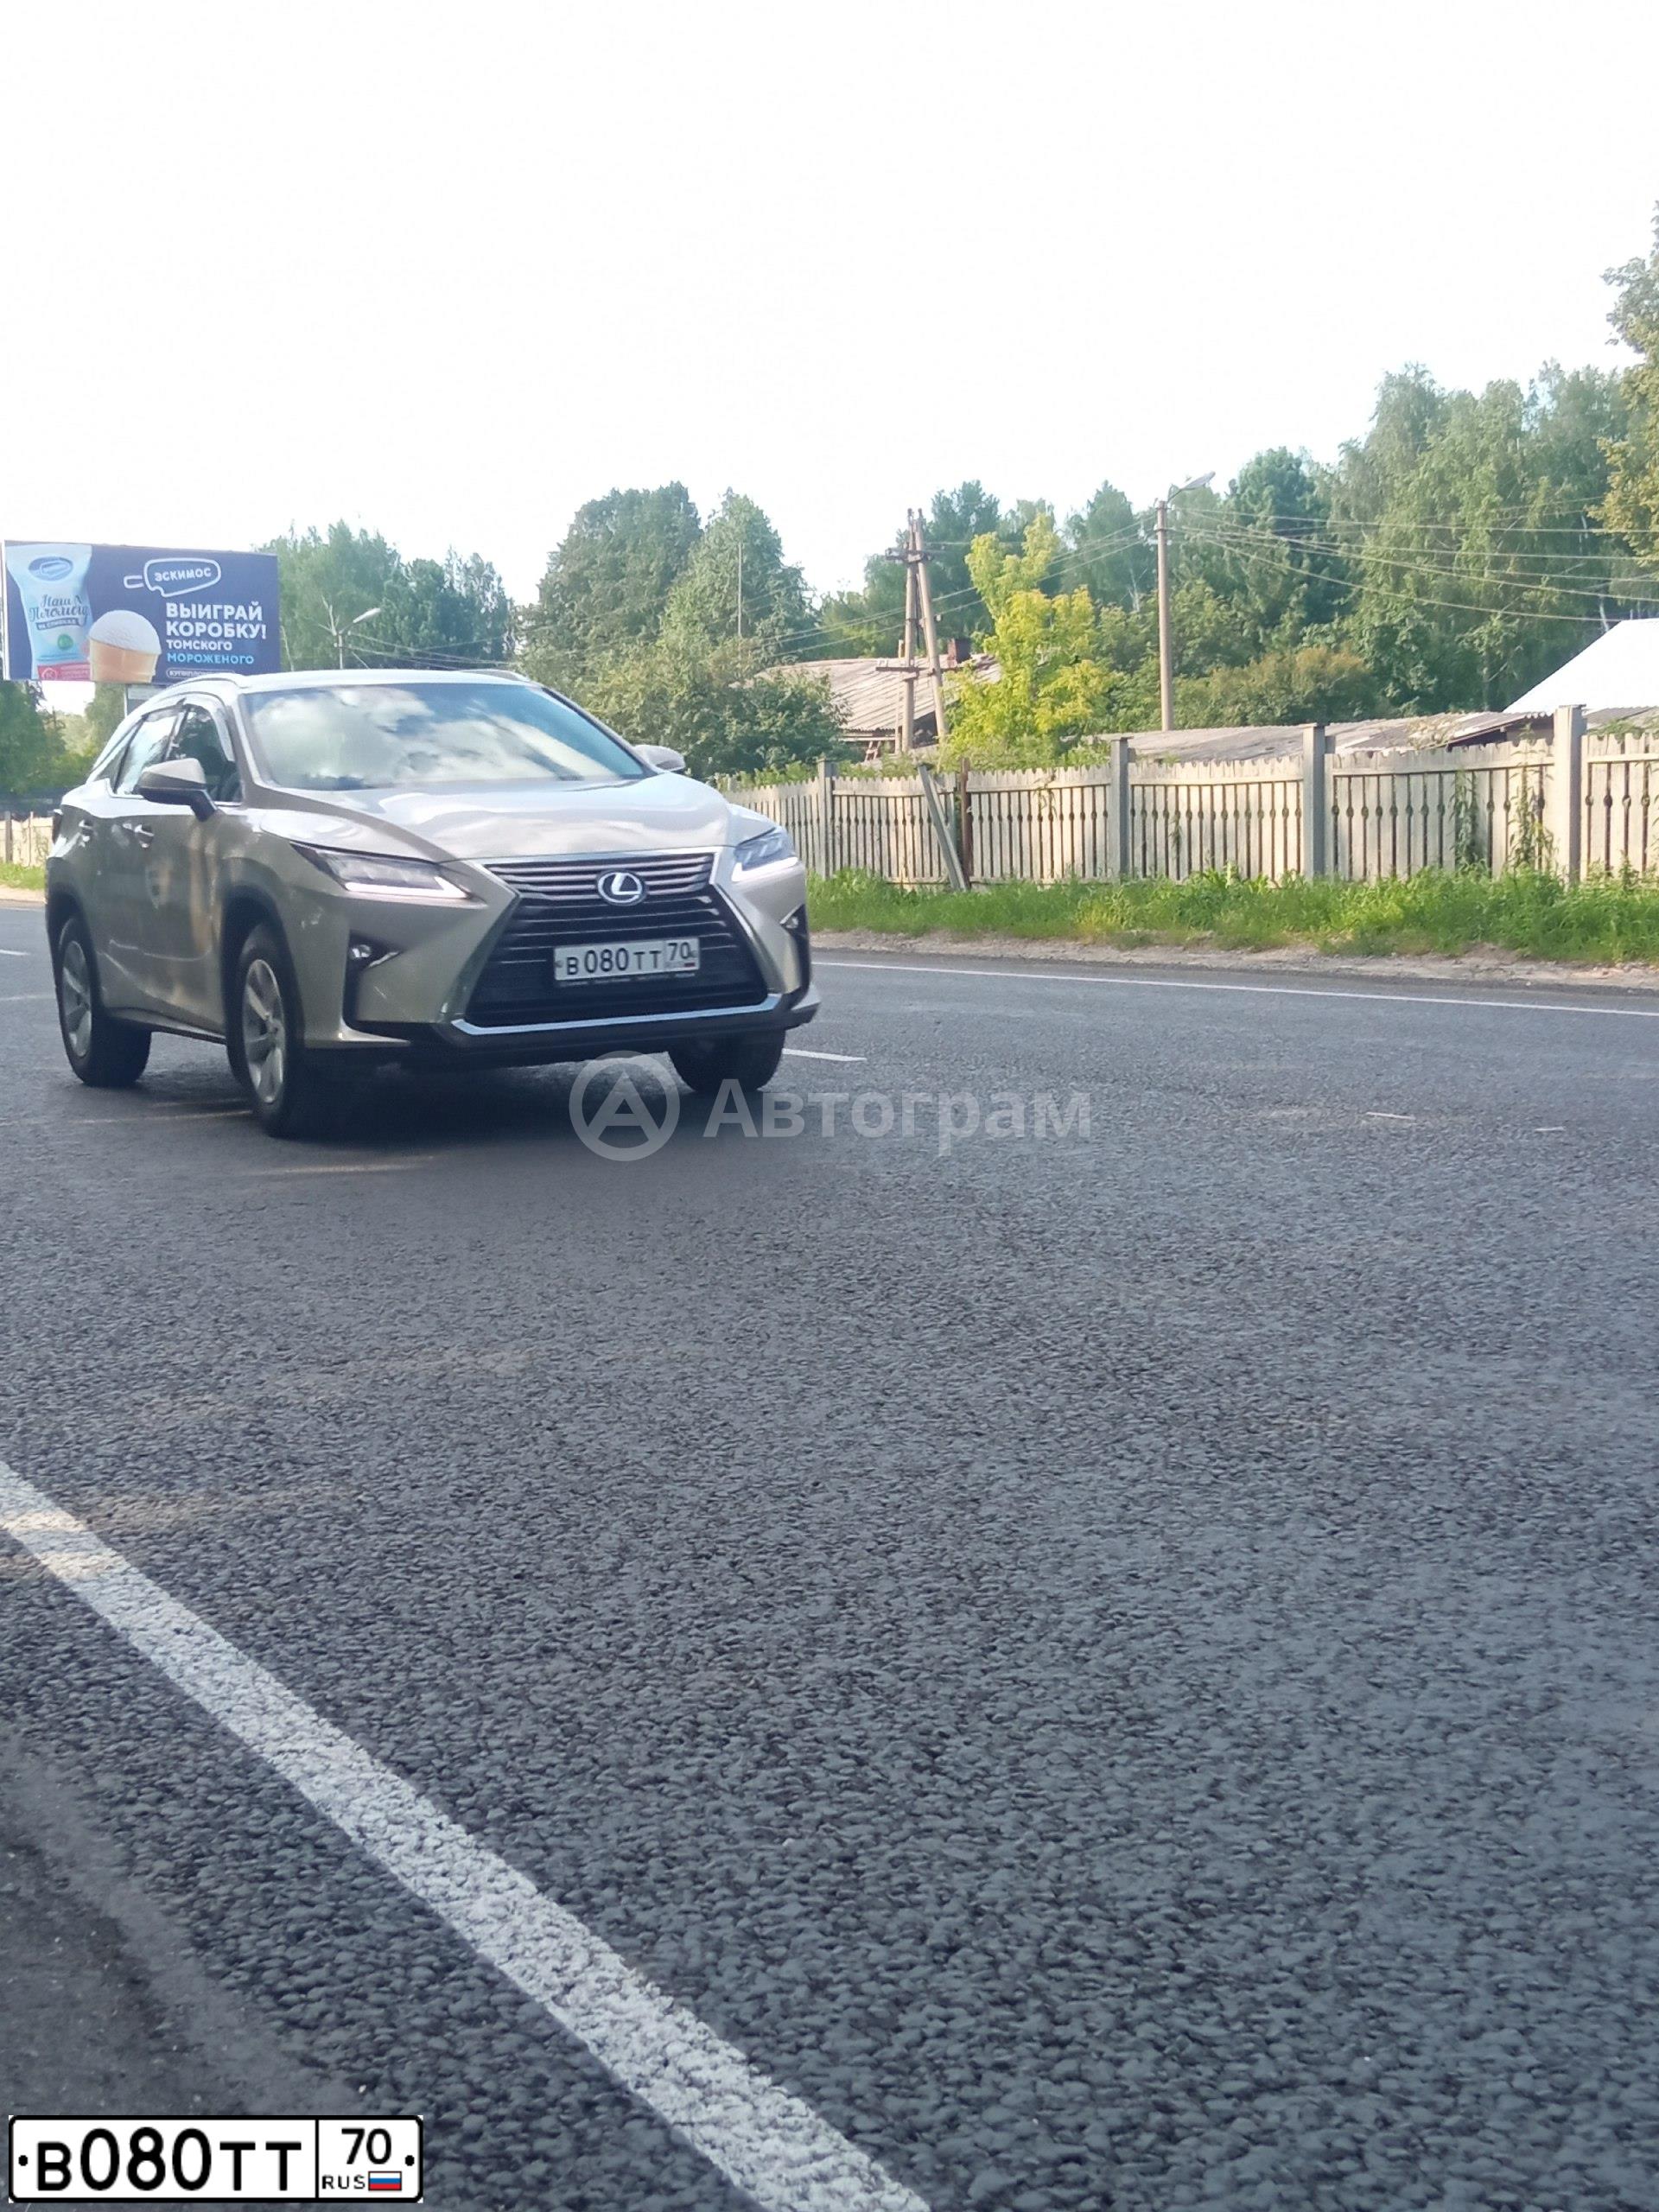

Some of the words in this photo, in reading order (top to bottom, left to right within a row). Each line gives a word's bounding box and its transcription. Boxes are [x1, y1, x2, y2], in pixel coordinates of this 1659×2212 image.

[155, 567, 213, 582] ЭСКИМОС
[166, 601, 263, 621] ВЫИГРАЙ
[166, 620, 267, 639] КОРОБКУ!
[166, 639, 233, 652] ТОМСКОГО
[167, 652, 255, 664] МОРОЖЕНОГО
